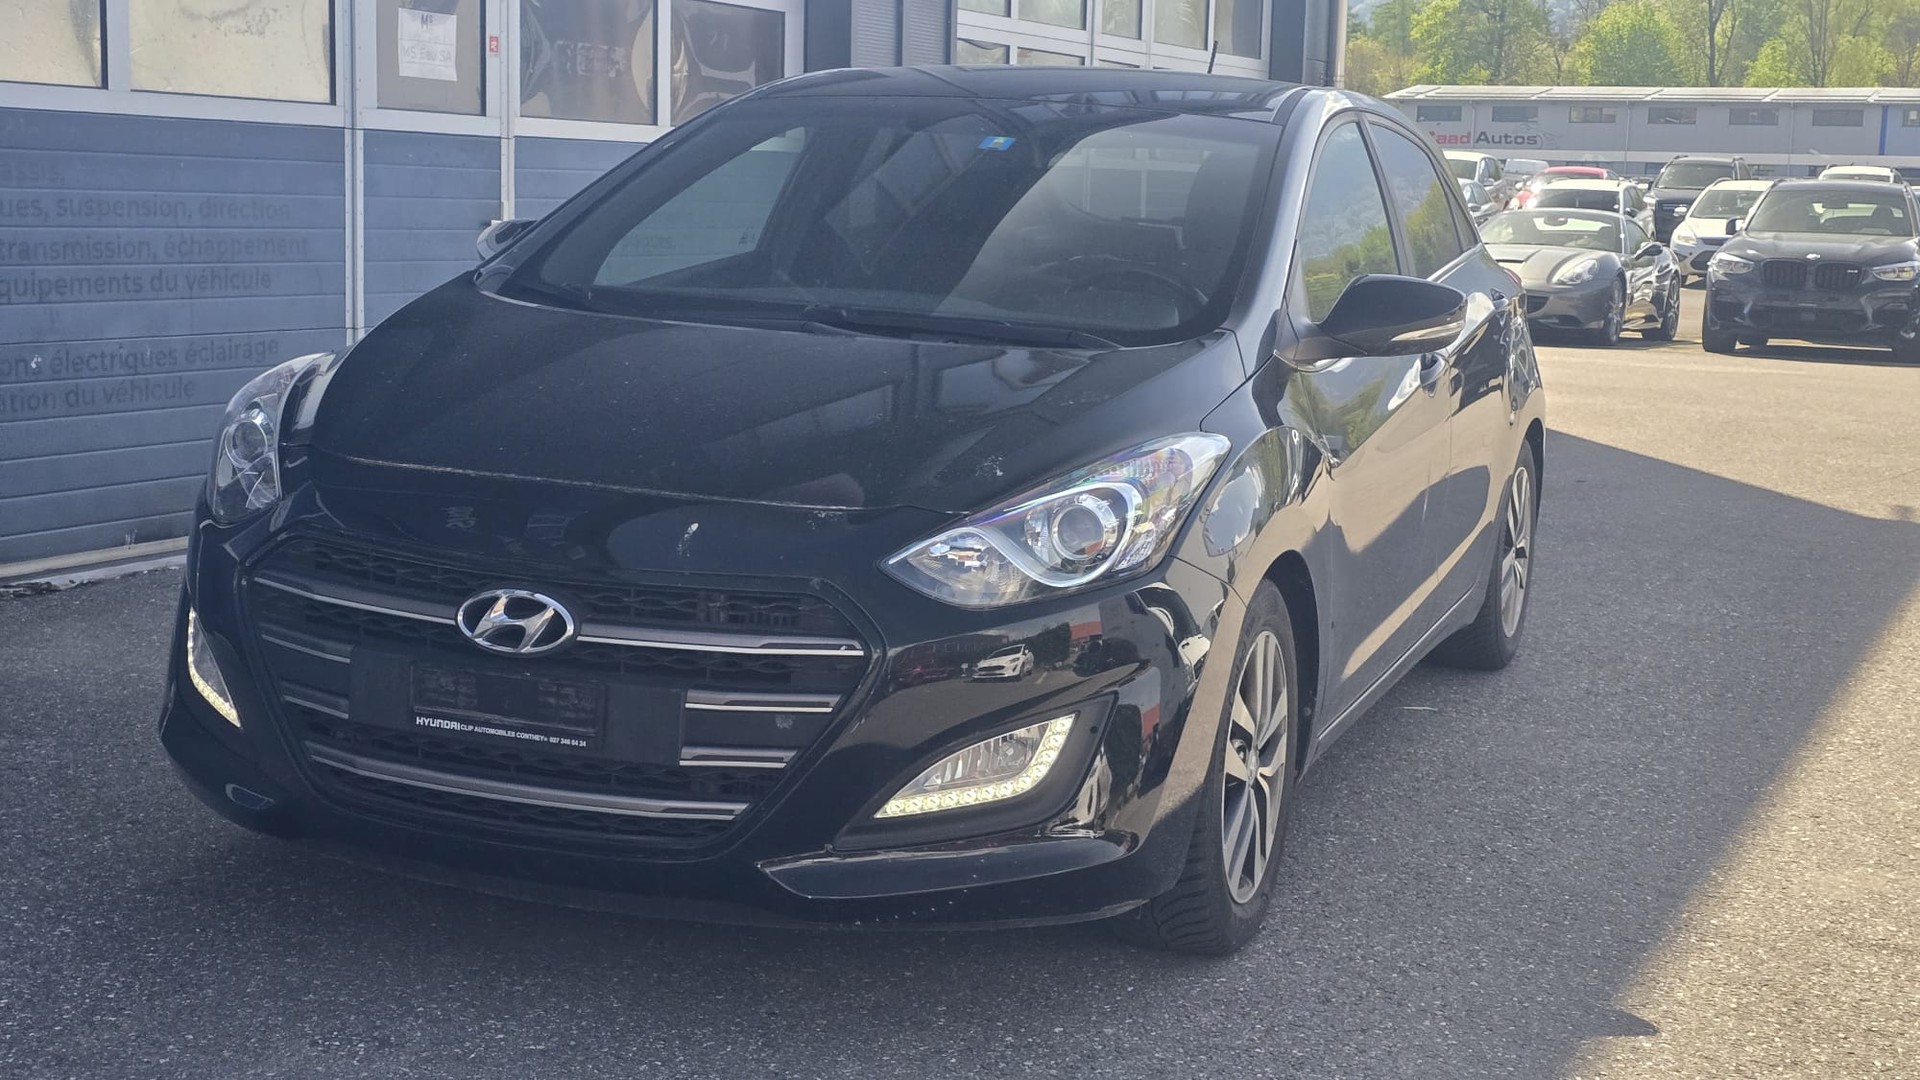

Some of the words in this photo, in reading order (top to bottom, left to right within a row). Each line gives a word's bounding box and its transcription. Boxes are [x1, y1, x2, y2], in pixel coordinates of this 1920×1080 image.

[1429, 131, 1471, 145] aad
[1475, 131, 1538, 145] Autos
[56, 195, 193, 224] suspension,
[199, 196, 291, 219] direction
[164, 233, 309, 261] échappement
[150, 270, 178, 294] du
[185, 267, 272, 292] véhicule
[50, 345, 178, 374] électriques
[185, 339, 279, 366] éclairage
[65, 383, 95, 407] du
[102, 376, 196, 404] véhicule
[416, 716, 460, 731] HYUNDAI
